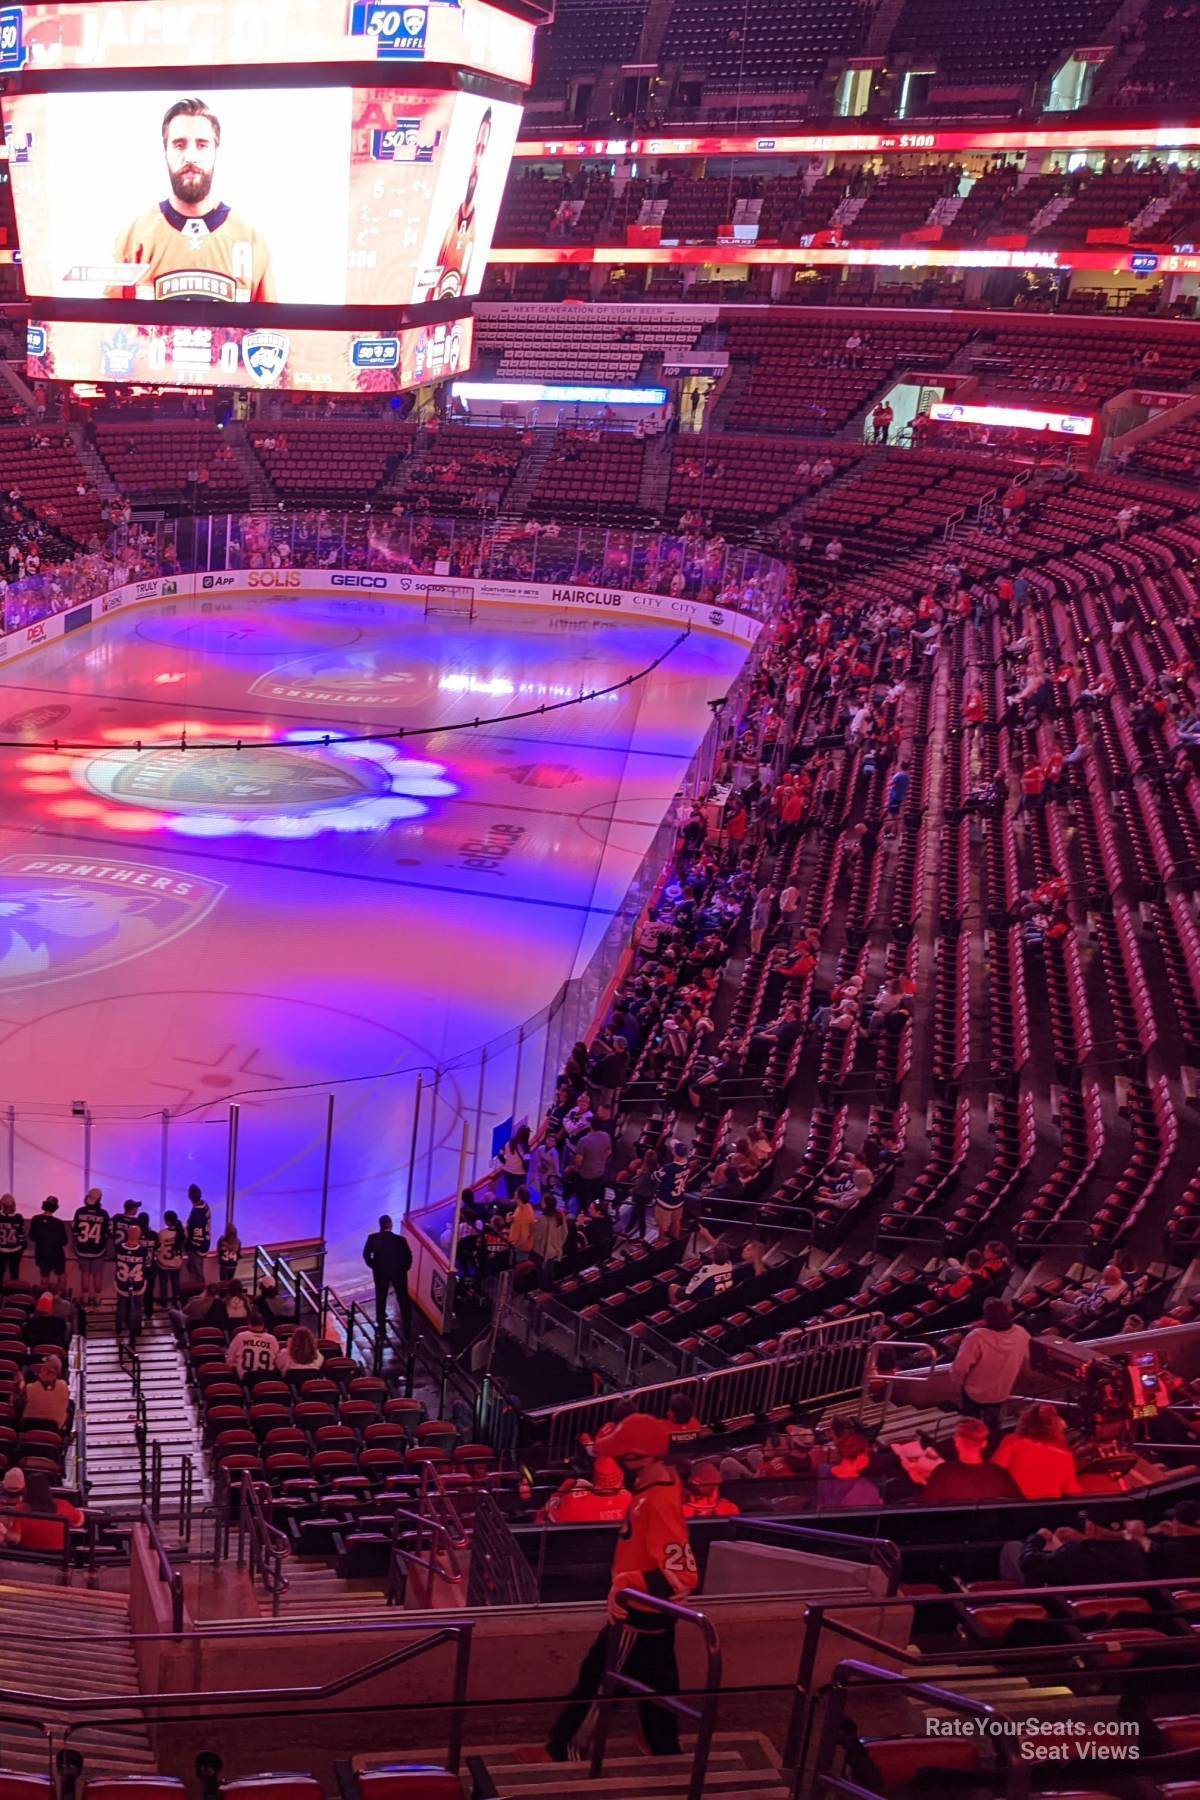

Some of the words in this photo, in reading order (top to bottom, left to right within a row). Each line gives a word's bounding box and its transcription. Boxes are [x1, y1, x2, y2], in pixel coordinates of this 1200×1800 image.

[368, 11, 401, 36] 50
[393, 38, 424, 48] RAFFL
[899, 136, 934, 149] $100
[221, 342, 238, 374] 0
[665, 367, 680, 376] 109
[247, 571, 302, 588] SOLIS
[331, 574, 388, 589] GEICO
[136, 582, 158, 594] TRULY
[552, 589, 621, 607] HAIRCLUB
[633, 596, 664, 608] CITY
[671, 601, 697, 614] CITY
[22, 861, 193, 896] PANTHERS
[77, 1221, 103, 1245] 34
[116, 1262, 144, 1282] 34
